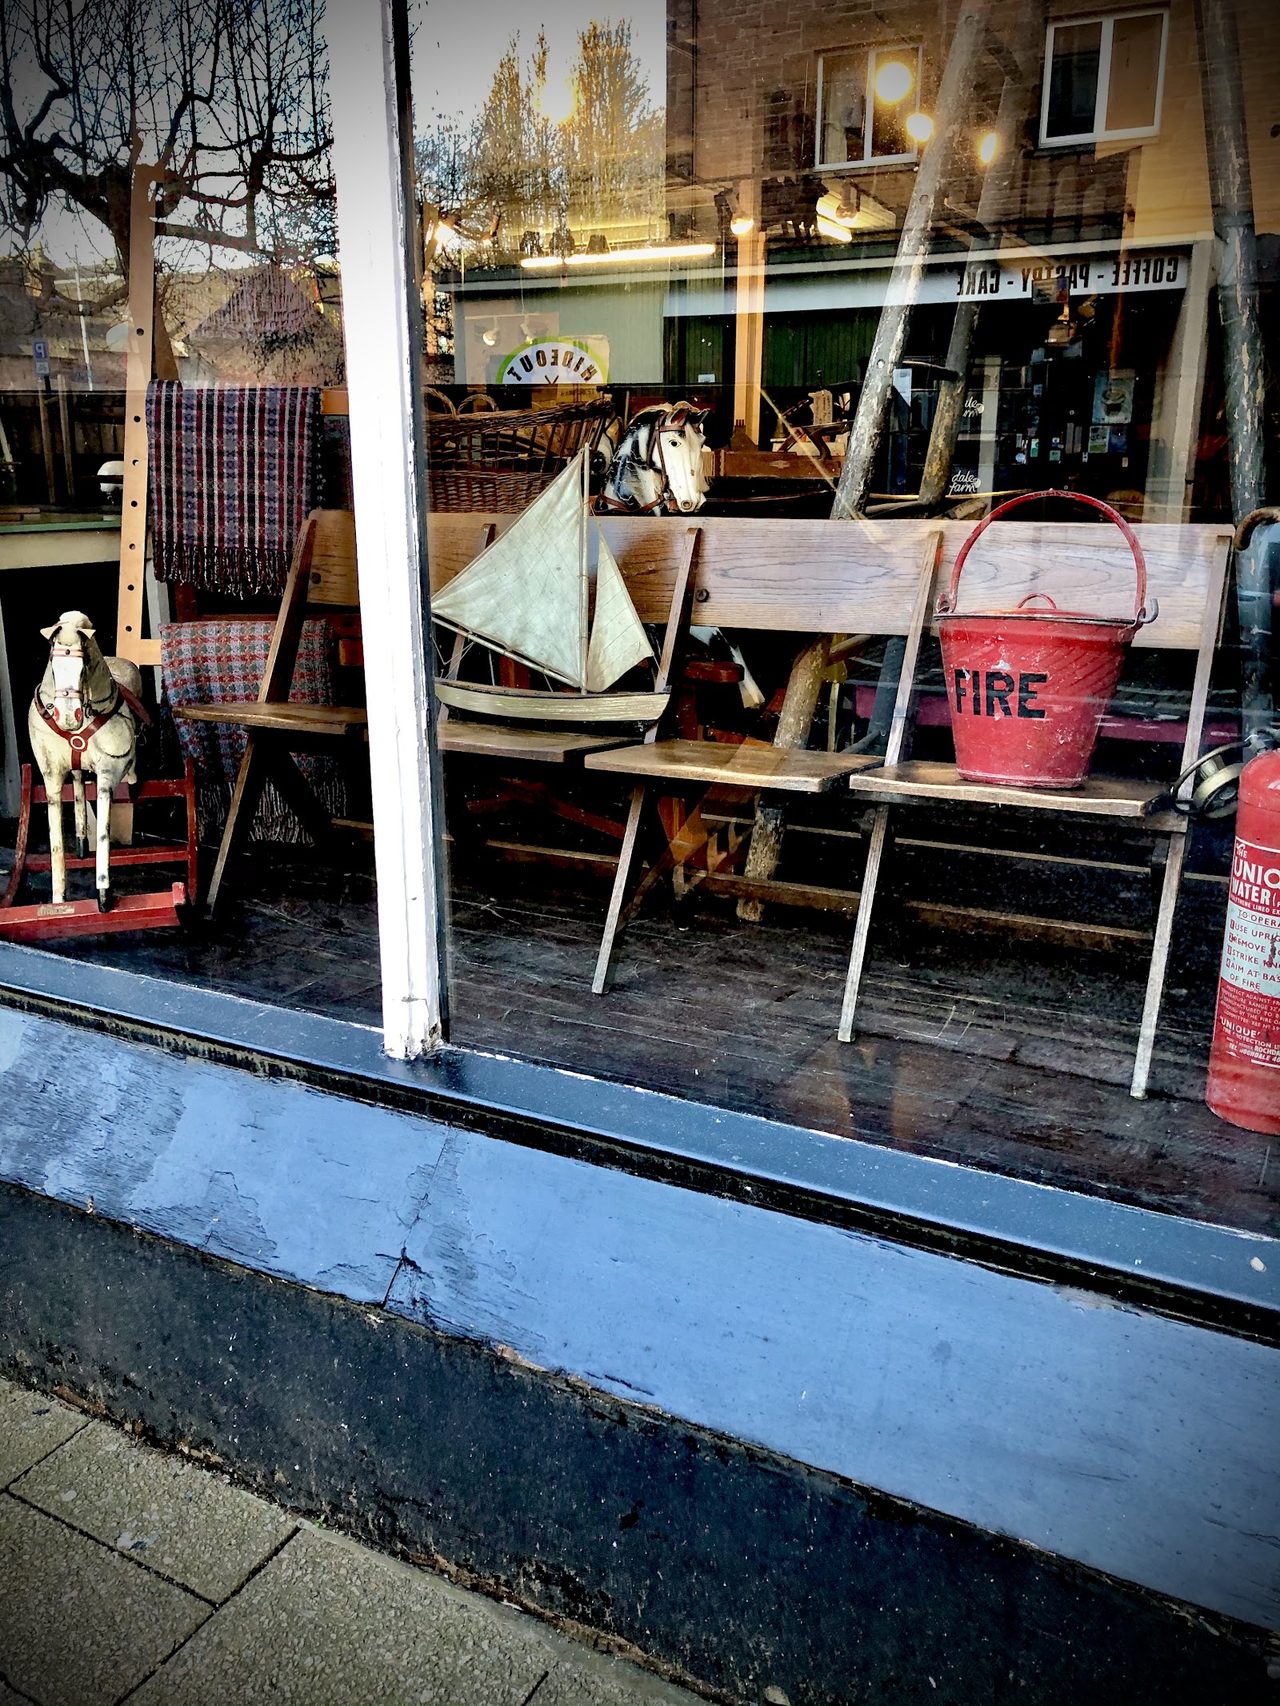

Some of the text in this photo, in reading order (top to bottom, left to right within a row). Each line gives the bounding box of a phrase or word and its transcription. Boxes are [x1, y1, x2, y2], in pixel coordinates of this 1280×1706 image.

[951, 469, 975, 484] dale
[948, 483, 976, 496] farm
[953, 668, 1049, 719] FIRE
[1231, 876, 1271, 906] WATER
[1238, 909, 1248, 919] TO
[1235, 922, 1248, 935] USE
[1233, 936, 1266, 954] REMOVE
[1232, 949, 1259, 965] STRIKE
[1231, 962, 1244, 974] AIM
[1247, 968, 1258, 978] AT
[1229, 973, 1261, 990] OF FIRE
